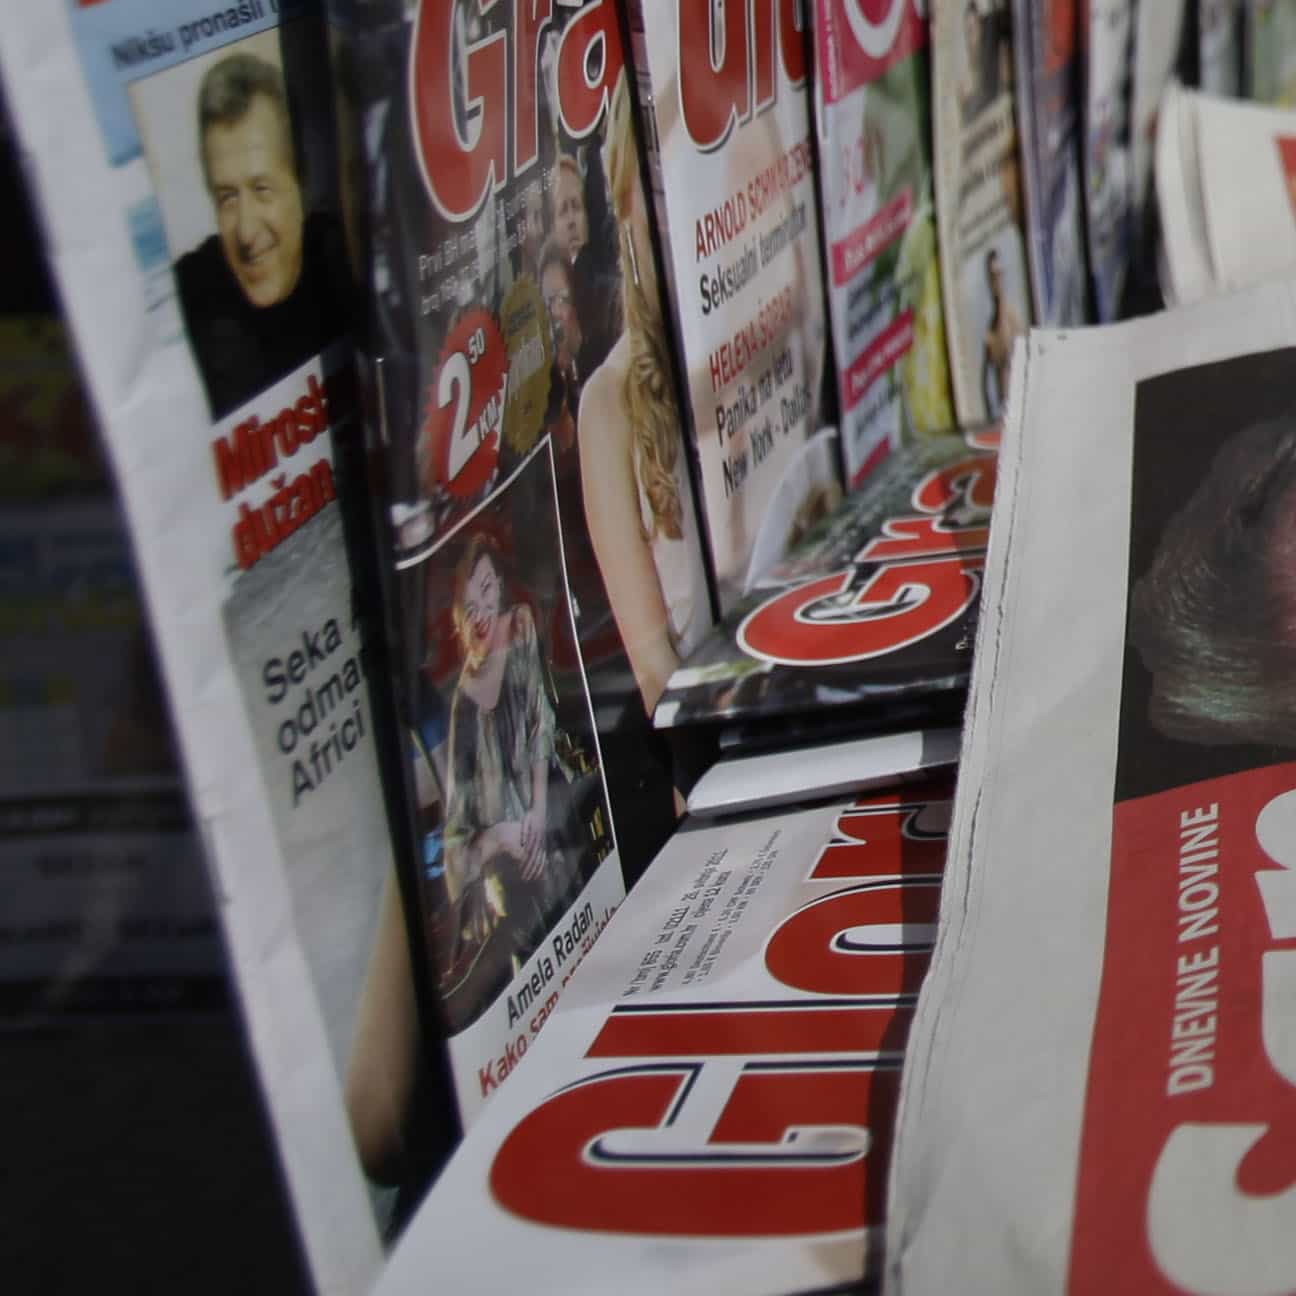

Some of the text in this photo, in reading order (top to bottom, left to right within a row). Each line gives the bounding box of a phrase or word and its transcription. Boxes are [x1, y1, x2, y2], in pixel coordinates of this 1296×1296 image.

[695, 192, 747, 262] ARNOLD
[468, 326, 486, 364] 50
[708, 325, 759, 393] HELENA
[437, 350, 480, 482] 2
[479, 396, 501, 441] KM
[715, 379, 758, 445] Panika
[737, 426, 1006, 667] Gra
[263, 616, 343, 706] Seka
[289, 700, 367, 808] Africi
[506, 957, 555, 1030] Amela
[553, 900, 595, 966] Radan
[1167, 801, 1220, 1097] DNEVNE NOVINE
[477, 991, 560, 1099] Kako sam
[487, 790, 957, 1239] Glor
